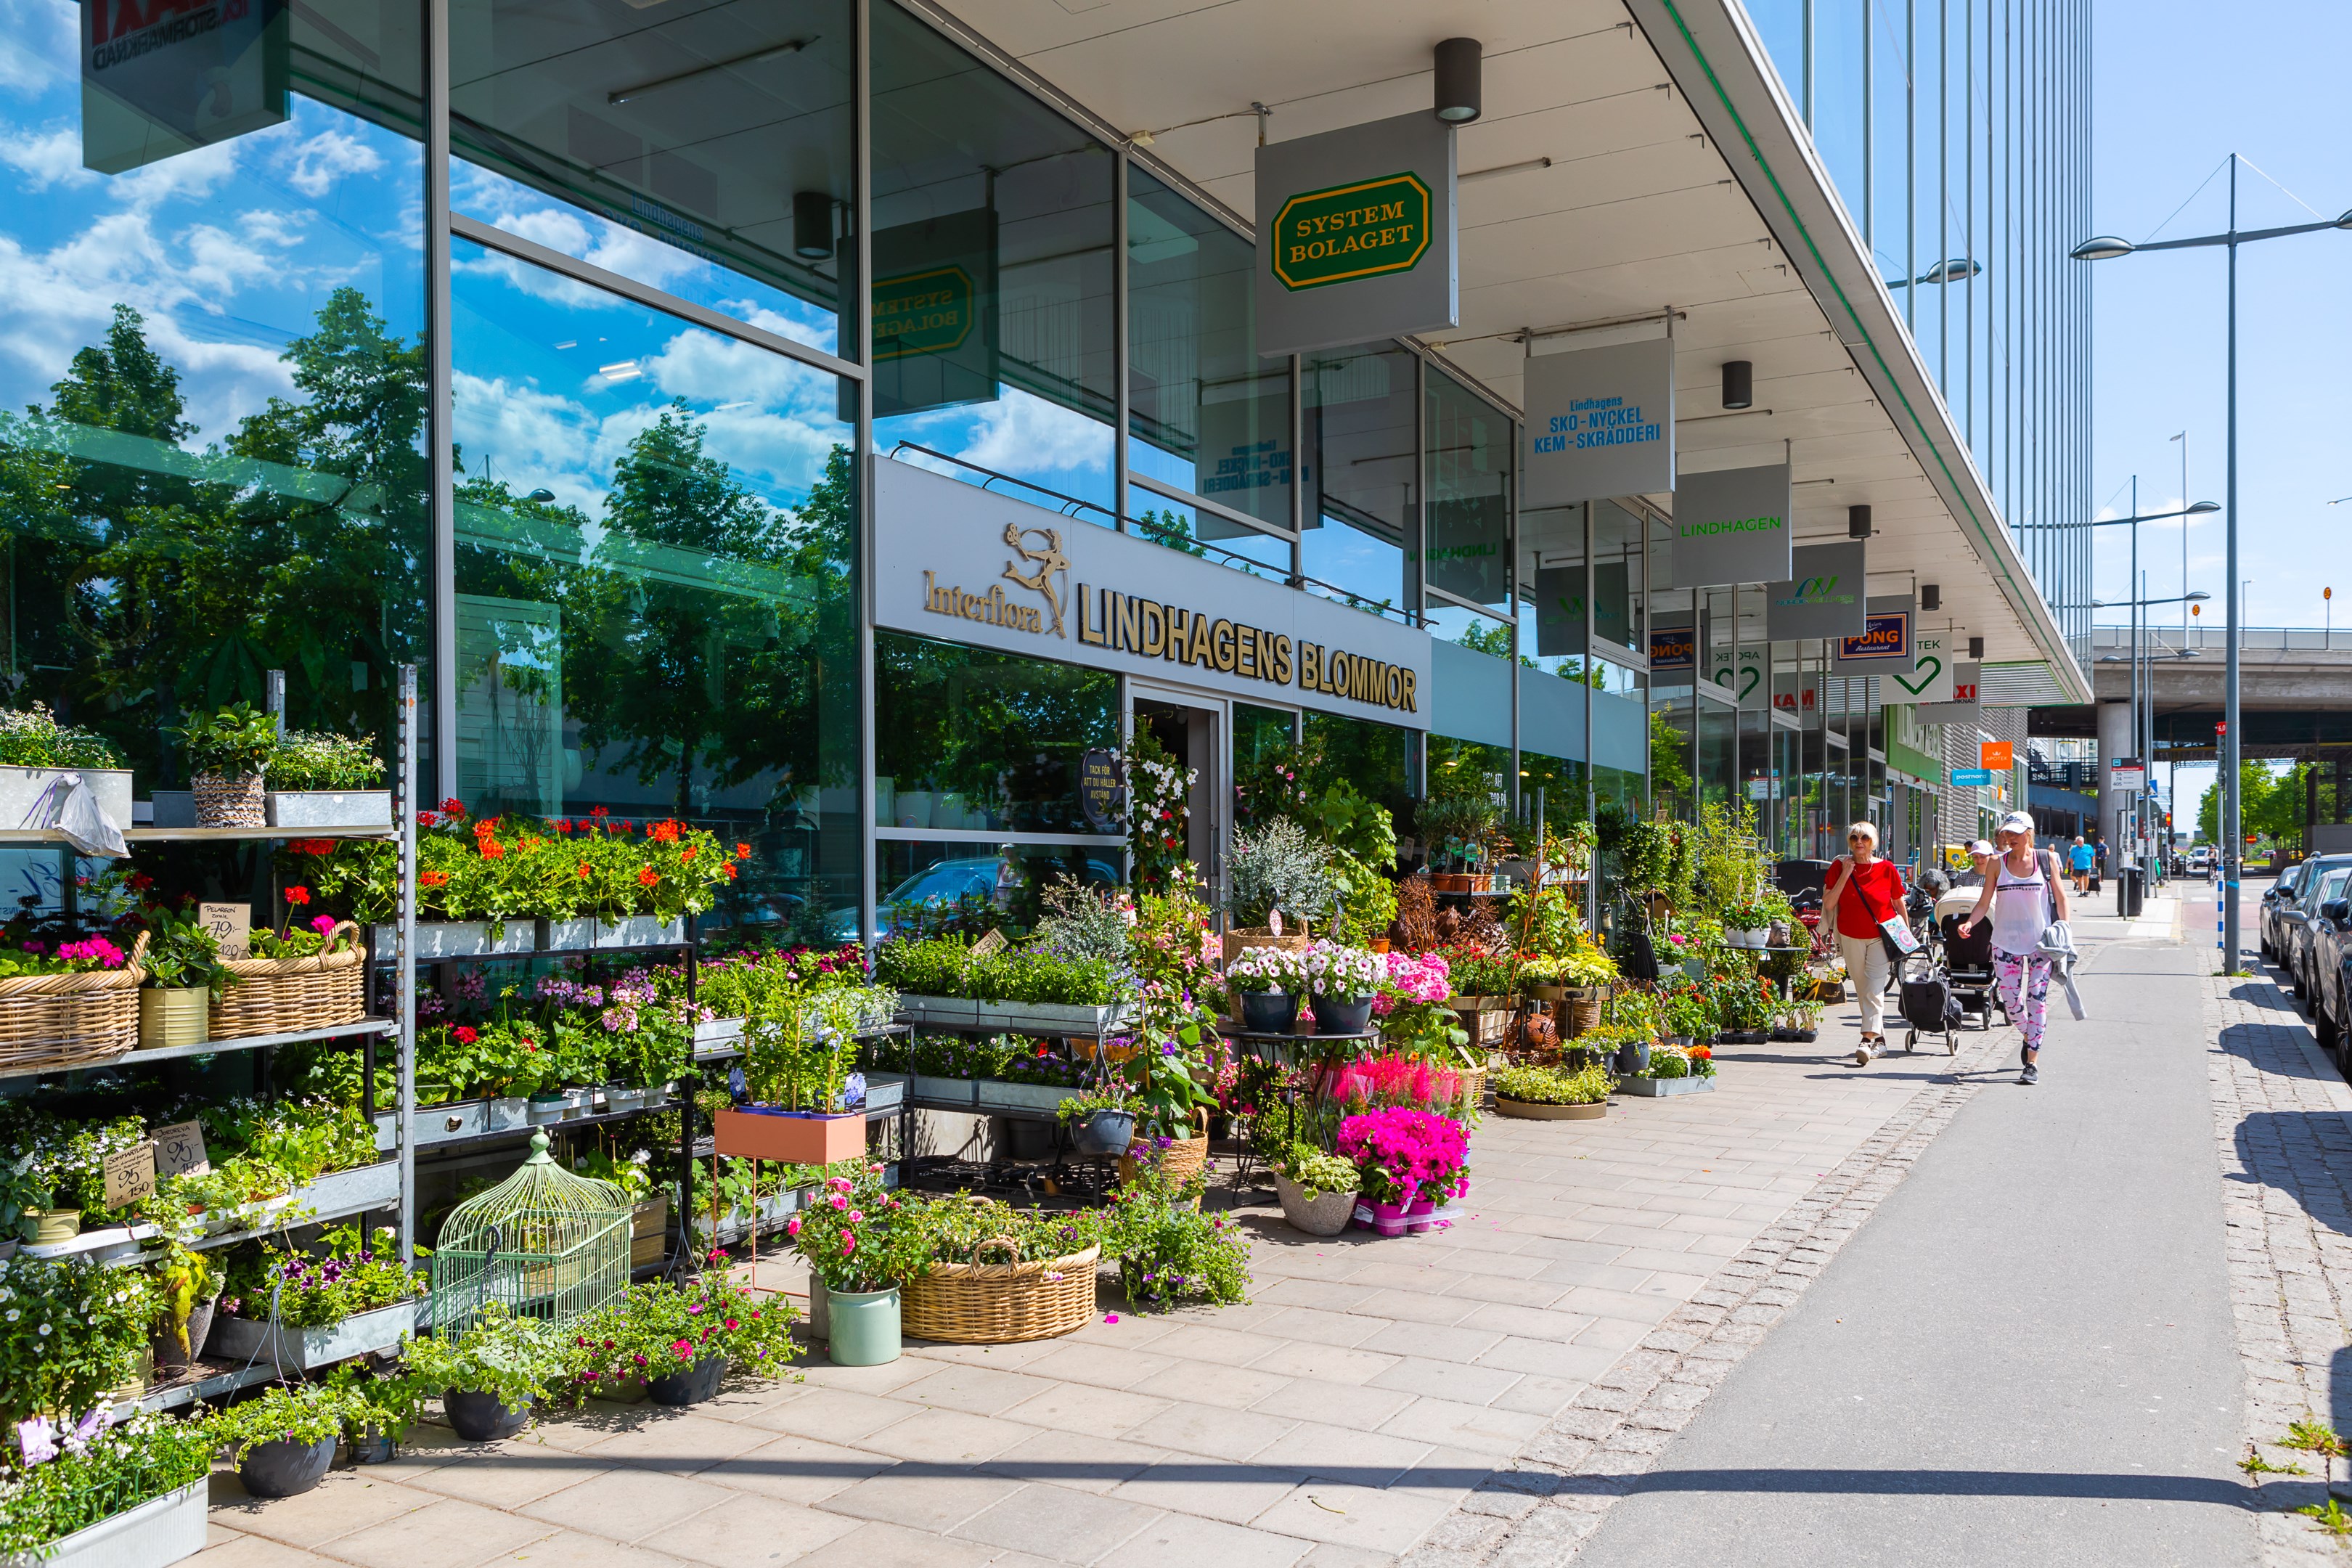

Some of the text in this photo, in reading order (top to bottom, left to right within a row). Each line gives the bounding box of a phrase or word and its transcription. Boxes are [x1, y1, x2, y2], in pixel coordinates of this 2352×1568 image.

[631, 192, 703, 242] Lindhagens
[1297, 200, 1405, 237] SYSTEM
[1289, 224, 1413, 264] BOLAGET
[1569, 396, 1622, 412] Lindhagens
[1550, 415, 1578, 433] SKO
[1589, 407, 1644, 428] NYCKEL
[1534, 436, 1566, 454] KEM
[1577, 424, 1661, 449] SKRÄDDERI
[1681, 516, 1781, 537] LINDHAGEN
[923, 570, 1043, 633] Interflora
[1078, 582, 1418, 712] LINDHAGENS BLOMMOR
[1847, 630, 1898, 645] PONG
[1916, 640, 1940, 650] TEK
[1090, 765, 1101, 775] TACK
[1090, 788, 1110, 799] AVSTÅND
[1093, 777, 1099, 786] DU
[1101, 777, 1116, 788] HÅLLER
